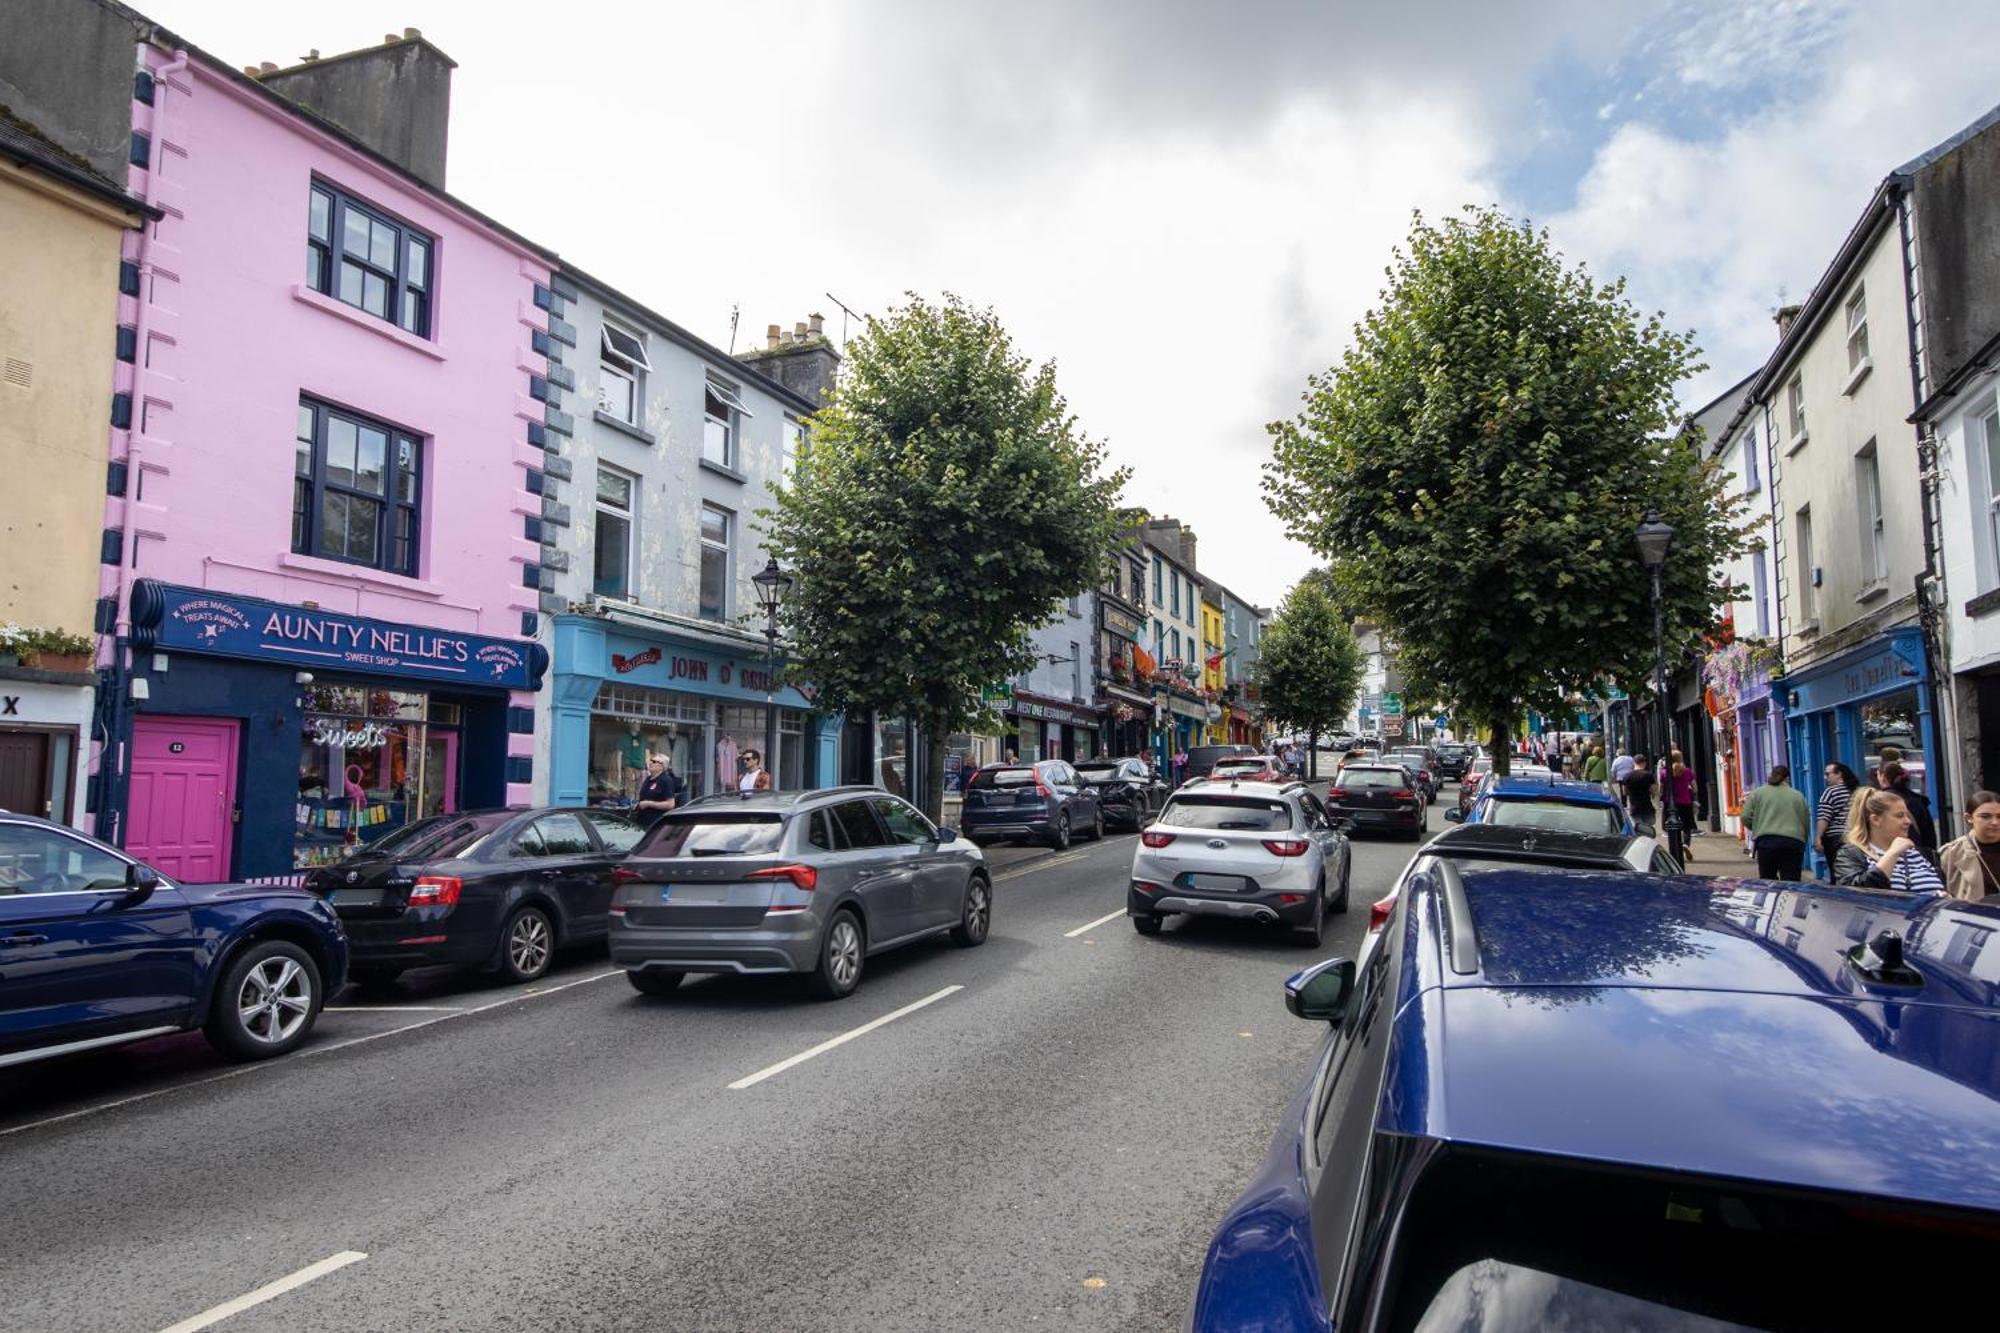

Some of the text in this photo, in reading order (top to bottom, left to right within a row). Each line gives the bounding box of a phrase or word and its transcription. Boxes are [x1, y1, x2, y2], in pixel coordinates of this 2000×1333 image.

[179, 601, 243, 620] WHERE MAGICAL
[184, 613, 212, 624] TREATS
[263, 613, 468, 662] AUNTY NELLIE'S
[344, 652, 400, 666] SWEET SHOP
[668, 656, 708, 682] JOHN
[3, 696, 20, 714] X
[1031, 703, 1044, 717] ONE
[313, 719, 387, 748] Sweets
